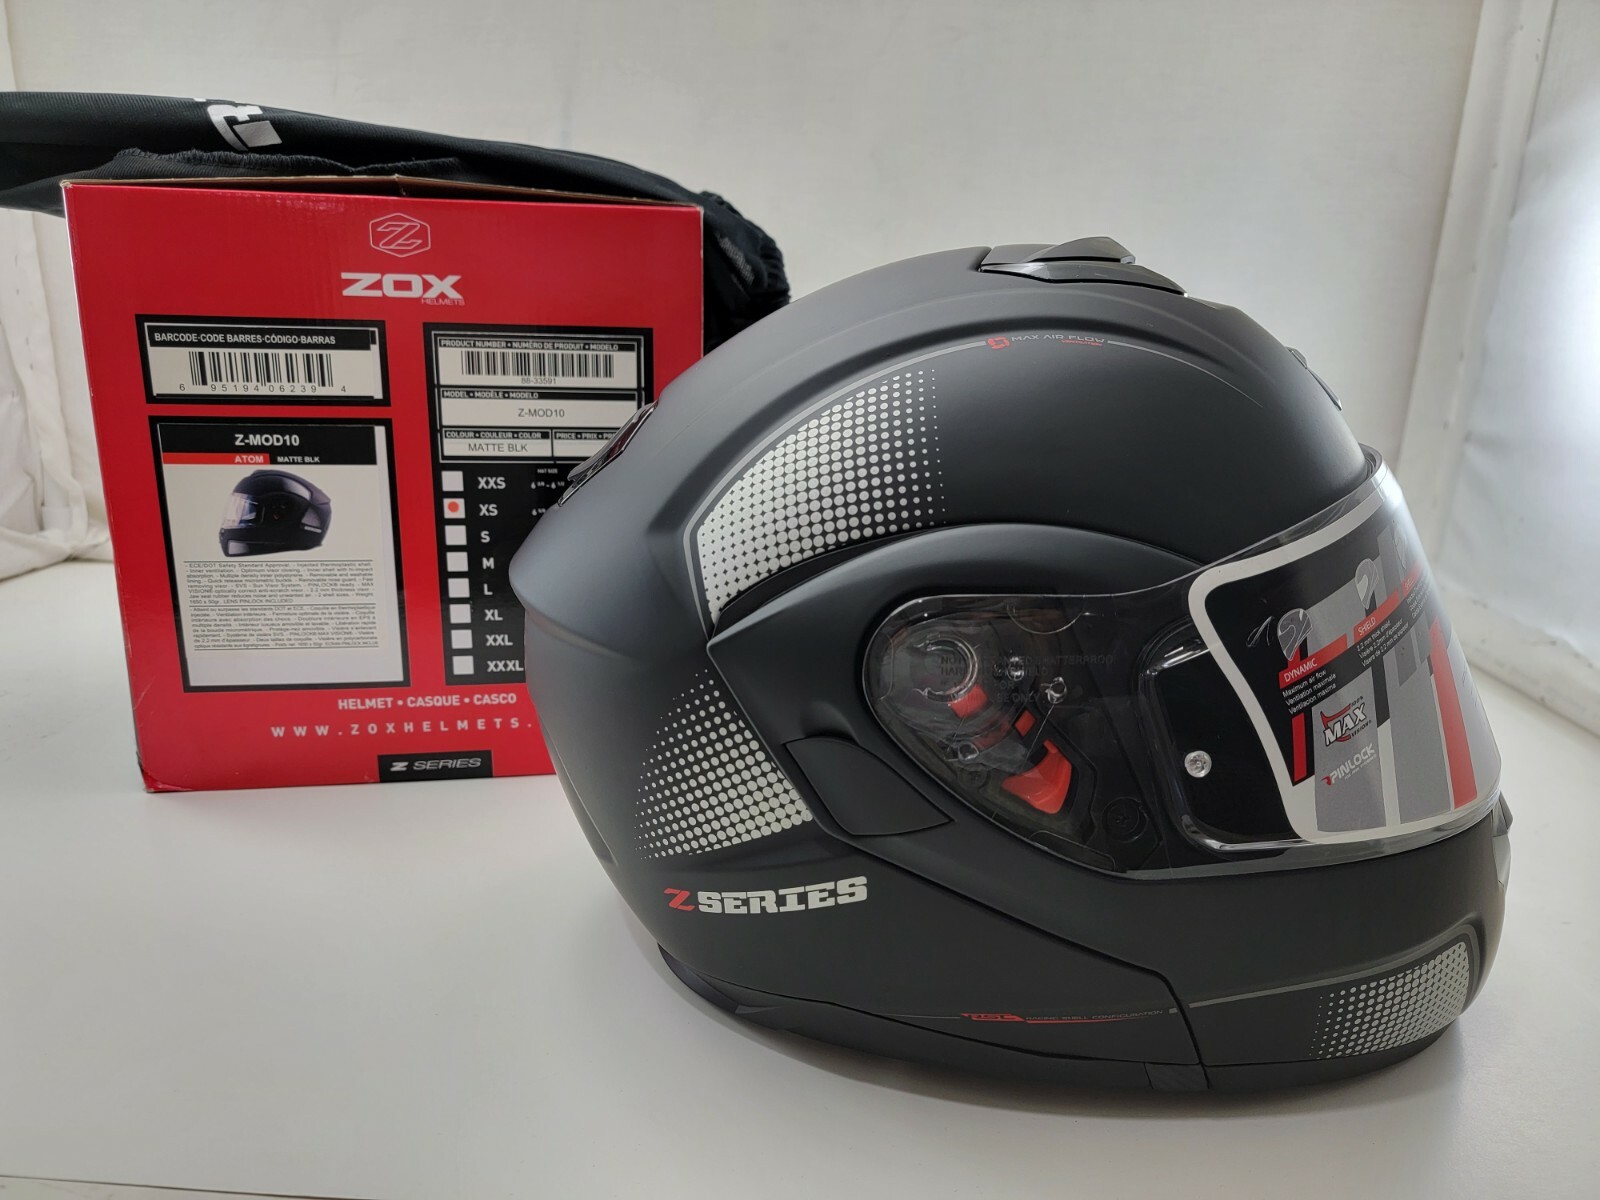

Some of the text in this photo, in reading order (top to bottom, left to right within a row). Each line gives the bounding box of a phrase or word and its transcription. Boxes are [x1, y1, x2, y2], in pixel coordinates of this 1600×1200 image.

[341, 272, 464, 299] ZOX
[518, 408, 565, 418] Z-MOD10
[234, 434, 300, 446] Z-MOD10
[468, 443, 528, 452] MATTE BLK
[234, 455, 264, 464] ATOM
[478, 476, 506, 490] XXS
[479, 504, 498, 516] XS
[480, 530, 490, 543] S
[482, 557, 494, 569] M
[484, 584, 493, 596] L
[484, 609, 503, 621] XL
[486, 634, 513, 646] XXL
[487, 660, 524, 672] XXXL
[1284, 658, 1318, 683] DYNAMIC
[338, 693, 517, 710] HELMET CASQUE CASCO
[1323, 702, 1367, 747] MAX
[412, 758, 482, 770] SERIES
[1330, 743, 1375, 784] PINLOCK
[664, 876, 868, 914] Z SERIES
